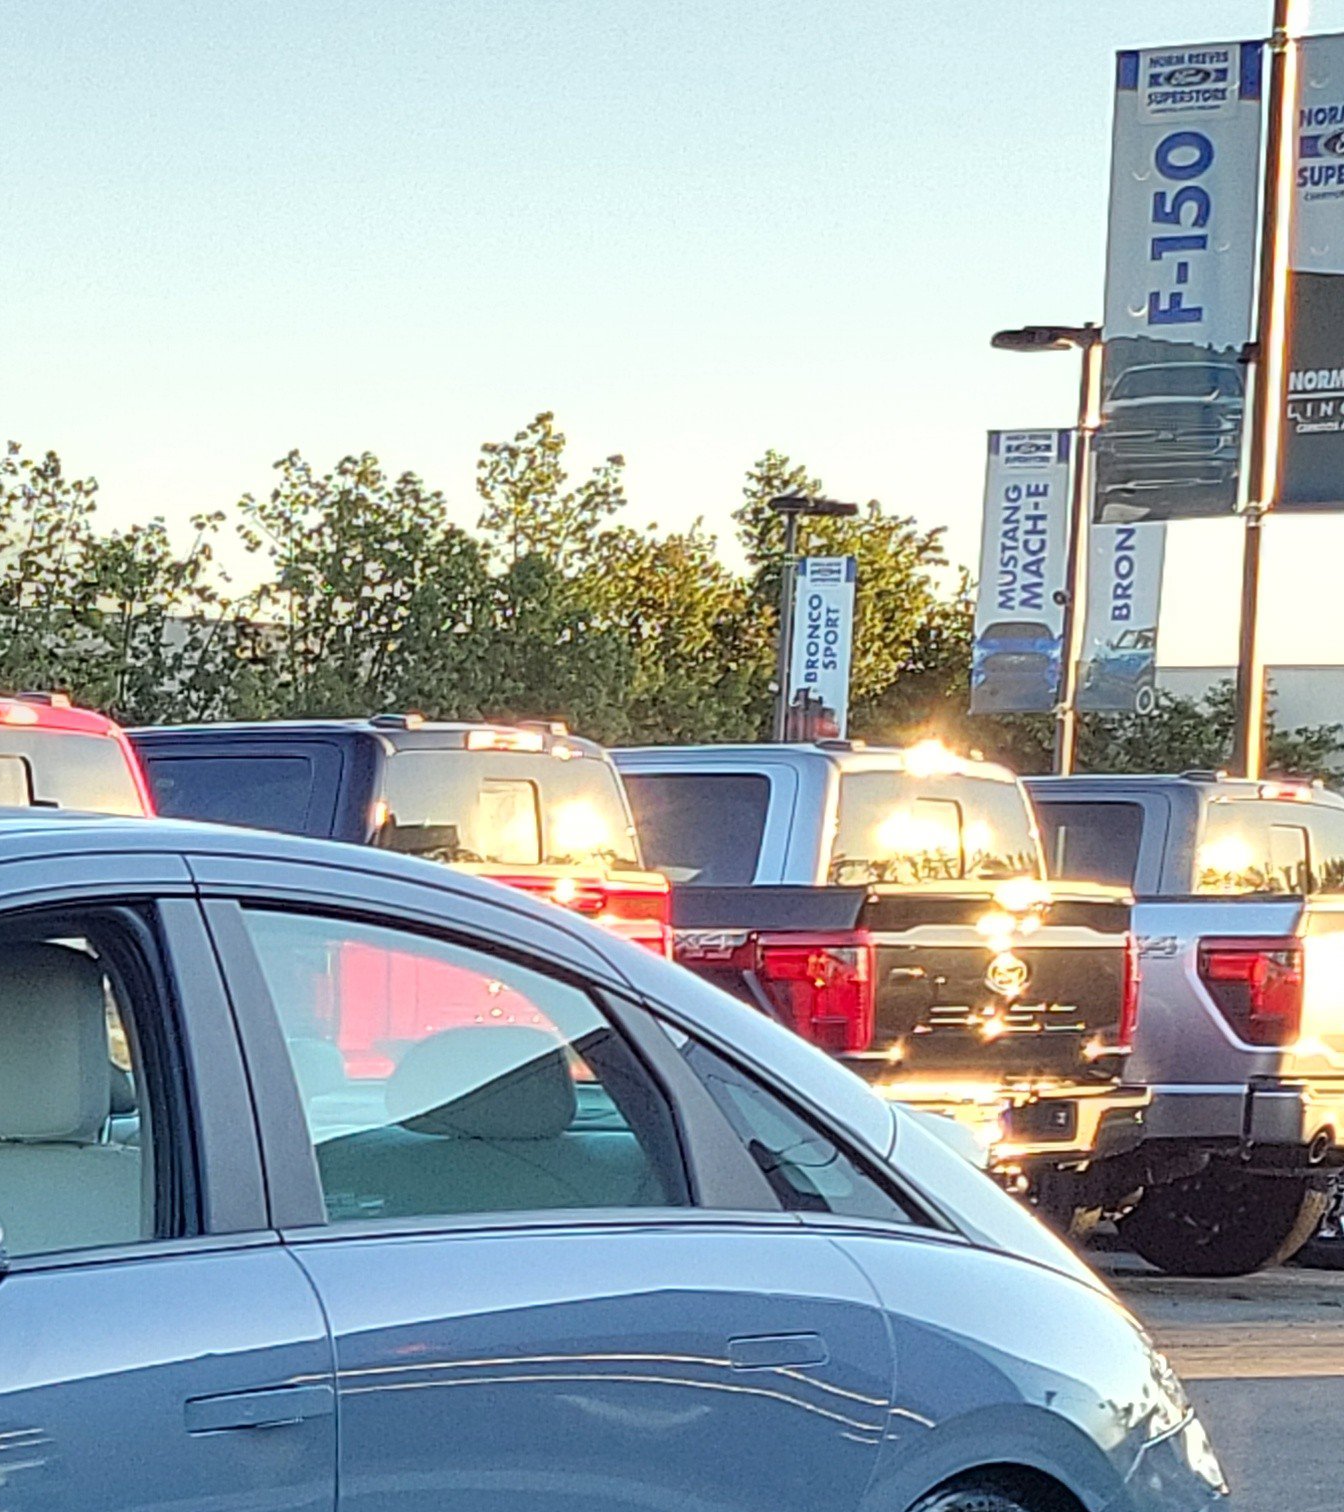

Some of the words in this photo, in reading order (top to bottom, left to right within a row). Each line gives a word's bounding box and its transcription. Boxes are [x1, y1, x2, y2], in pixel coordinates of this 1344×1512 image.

[1299, 105, 1344, 127] NOR
[1148, 131, 1214, 325] F-150
[1287, 401, 1344, 418] LIN
[998, 484, 1022, 611] MUSTANG
[1019, 483, 1049, 610] MACH-E
[1111, 526, 1136, 621] BRON
[804, 594, 823, 683] BRONCO
[822, 606, 840, 670] SPORT
